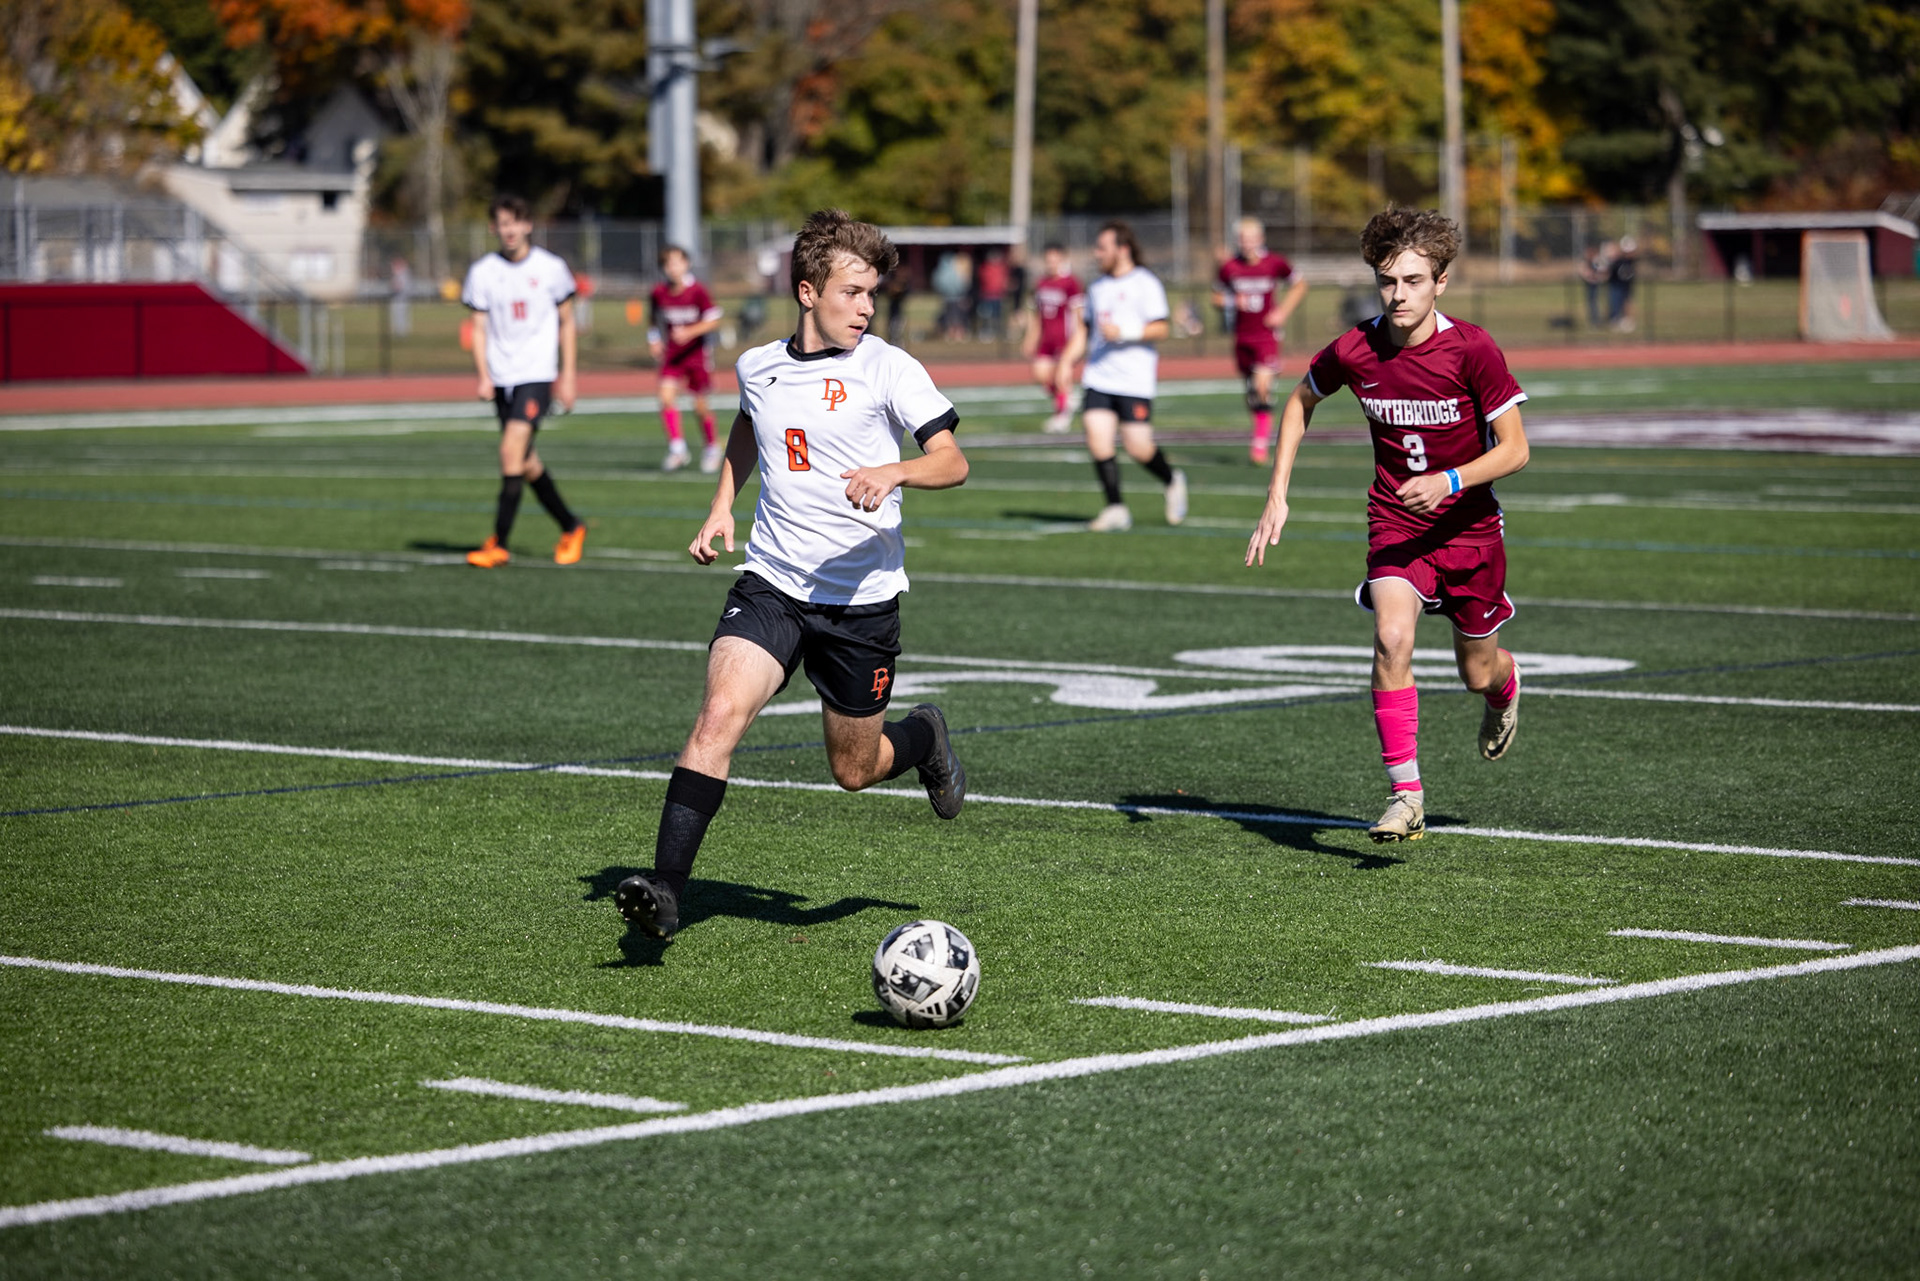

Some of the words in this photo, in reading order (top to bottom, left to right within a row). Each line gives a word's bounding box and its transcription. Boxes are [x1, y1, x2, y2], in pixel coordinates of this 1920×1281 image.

[821, 378, 848, 412] DP
[785, 428, 811, 471] 8
[1402, 434, 1428, 472] 3
